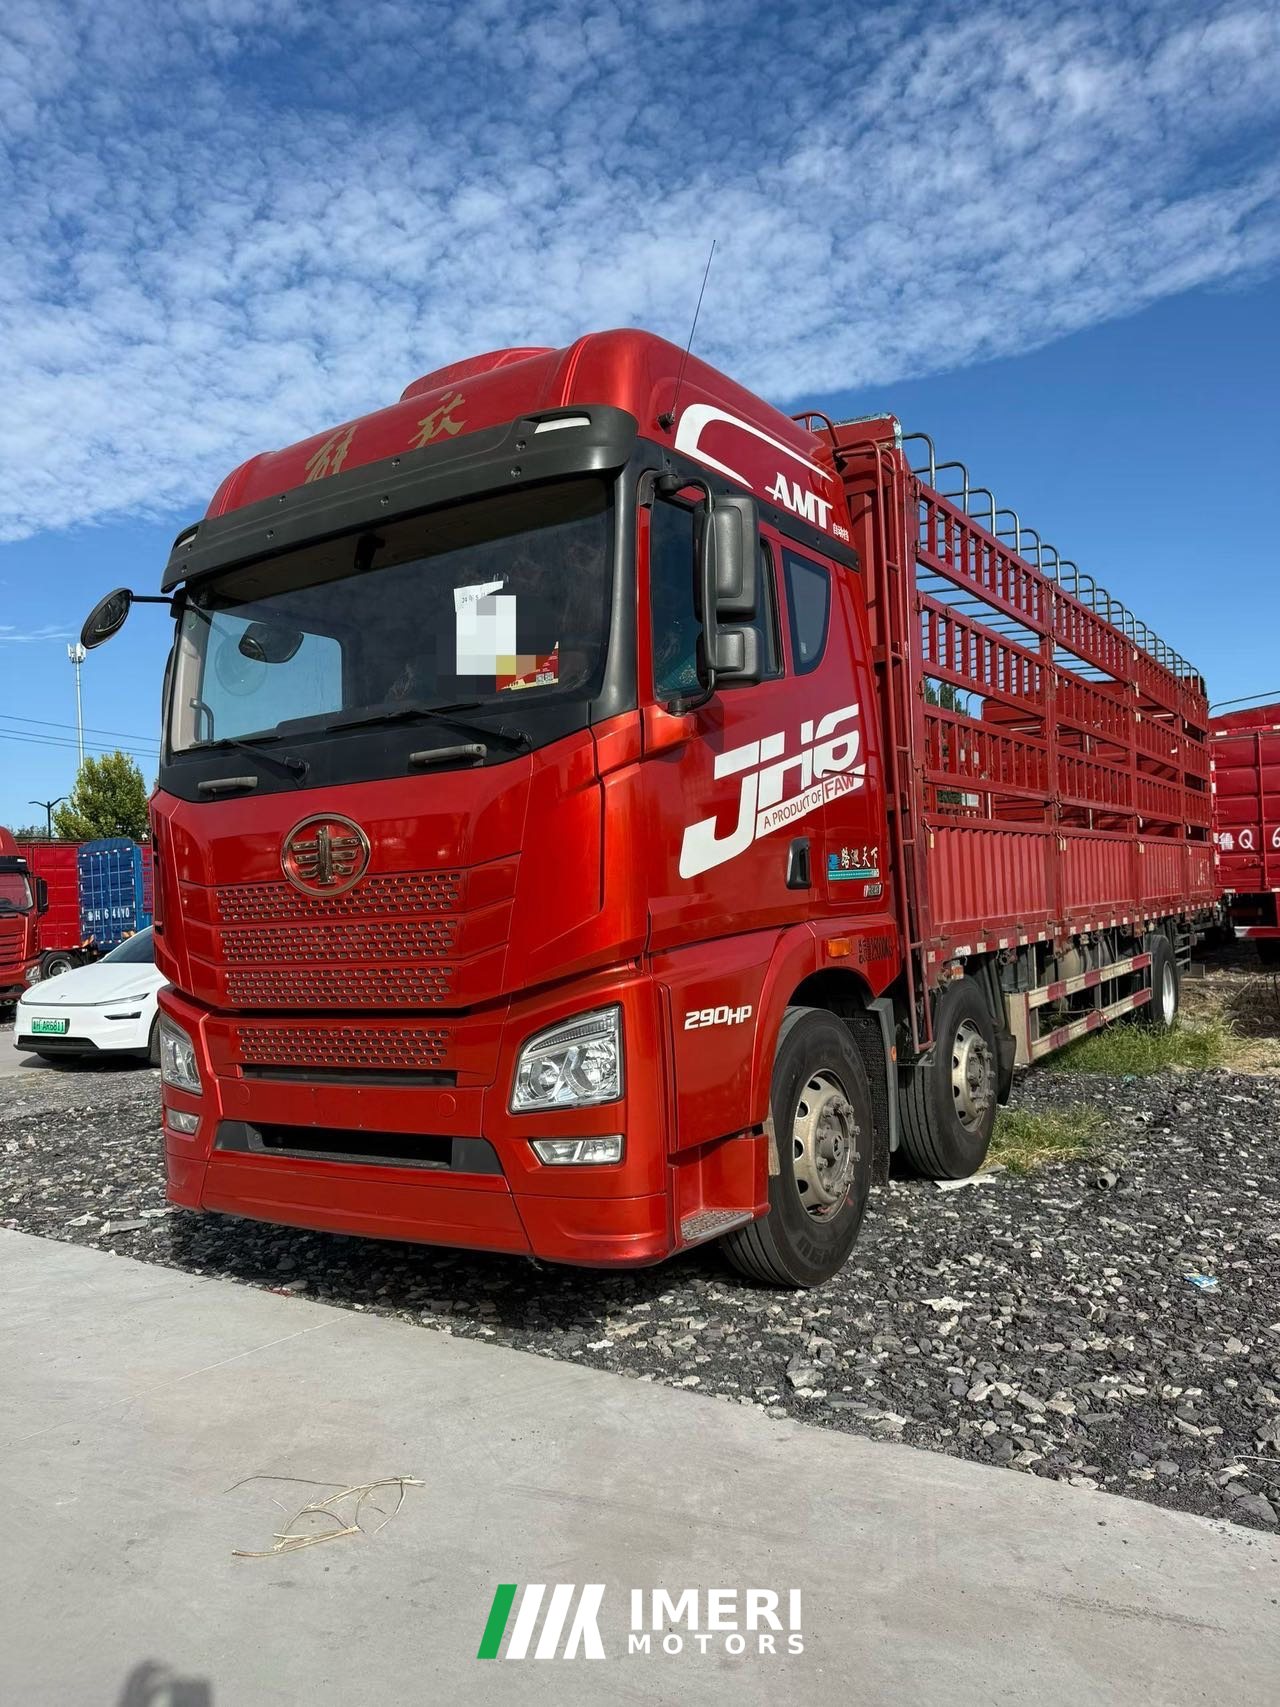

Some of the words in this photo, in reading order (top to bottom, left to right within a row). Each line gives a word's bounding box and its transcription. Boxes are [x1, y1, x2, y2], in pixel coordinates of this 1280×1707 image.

[764, 472, 834, 530] AMT
[678, 703, 860, 880] JH6
[763, 815, 772, 829] A
[772, 796, 811, 825] PRODUCT
[811, 789, 822, 804] OF
[824, 772, 855, 800] FAW
[684, 1004, 753, 1031] 290HP
